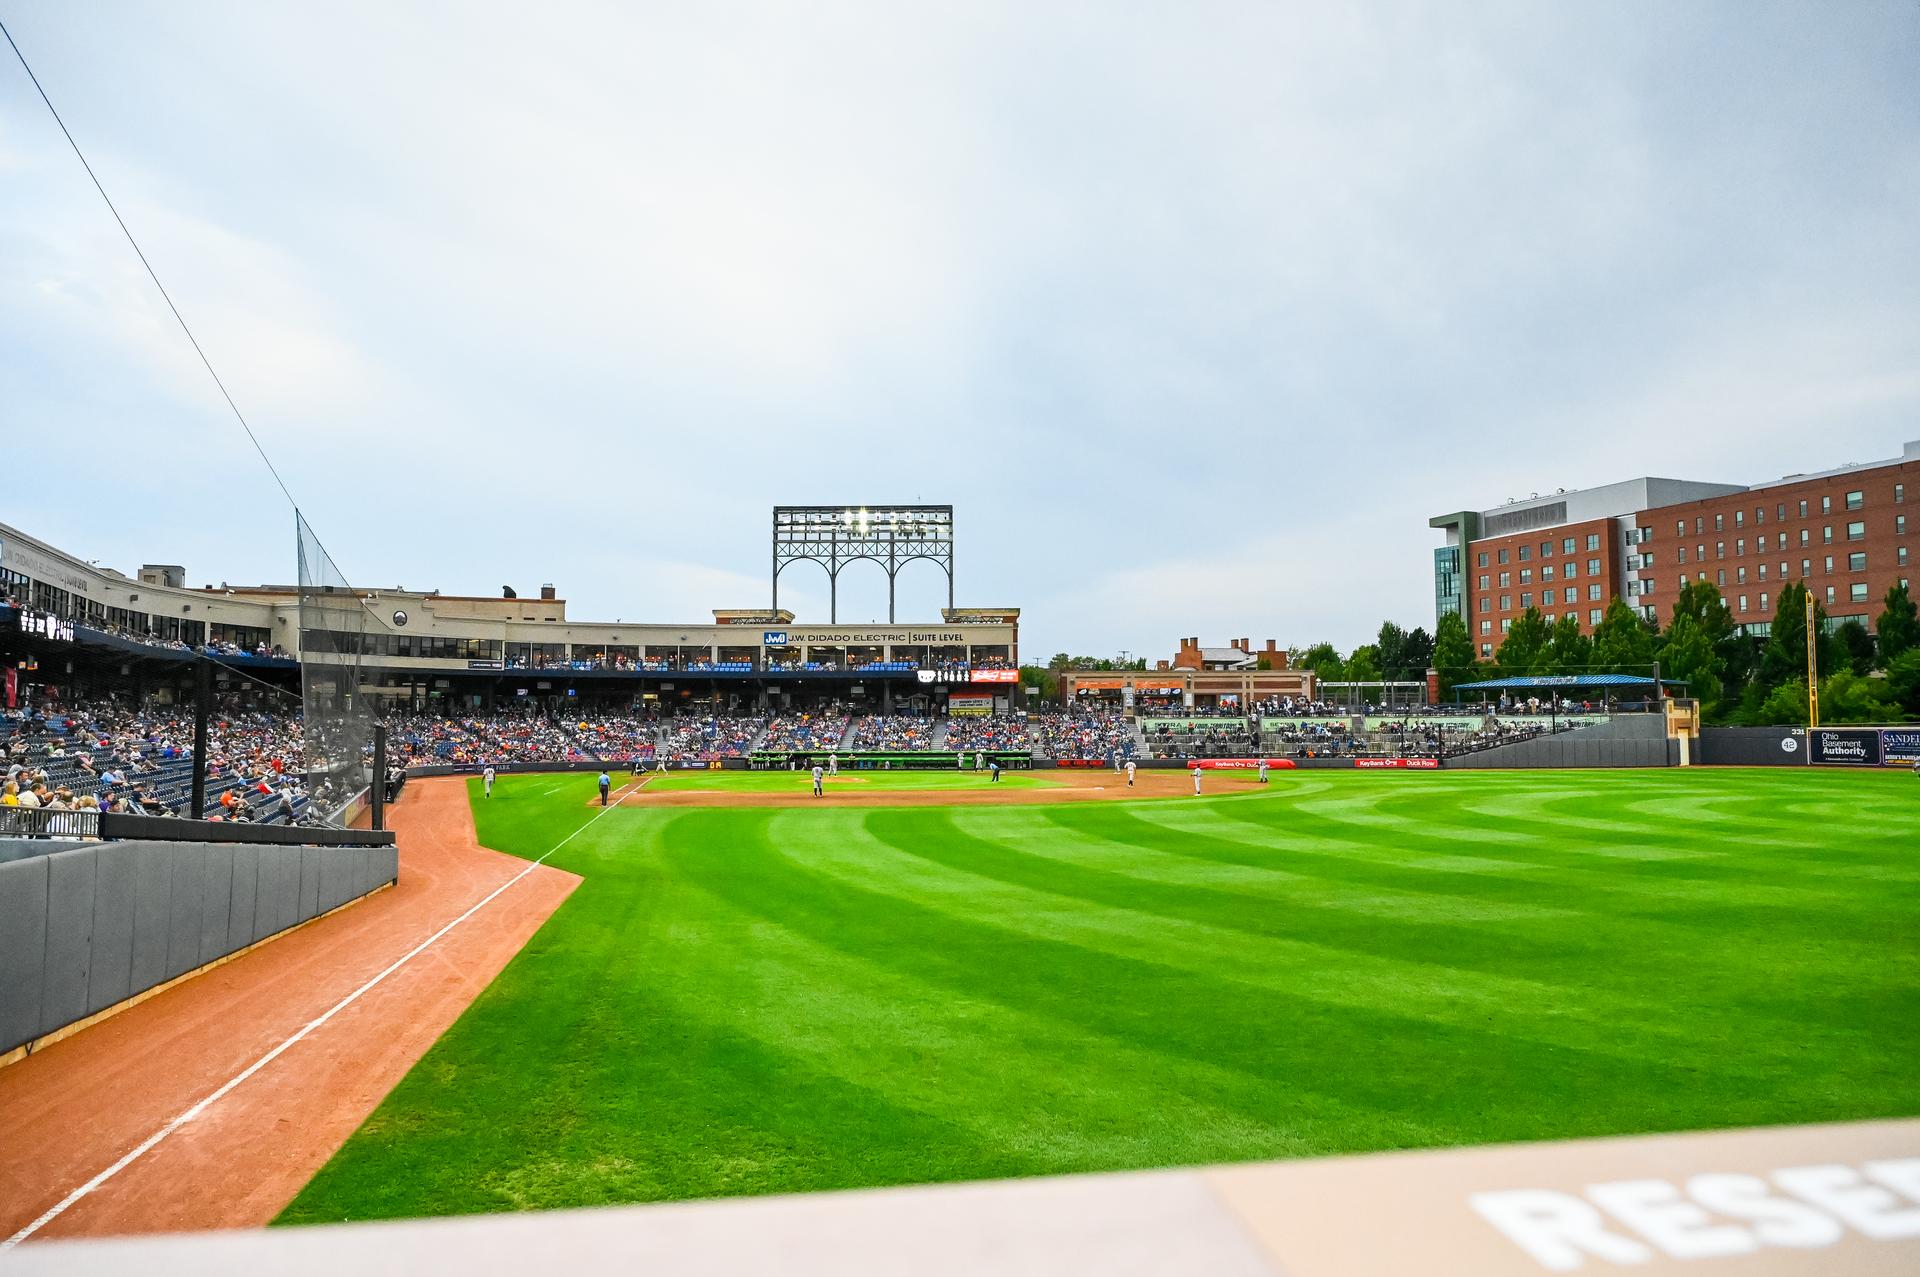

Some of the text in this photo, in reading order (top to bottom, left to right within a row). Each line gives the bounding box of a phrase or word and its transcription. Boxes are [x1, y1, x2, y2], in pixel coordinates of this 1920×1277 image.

[807, 634, 851, 642] DIDADO
[853, 634, 906, 642] ELECTRIC
[912, 633, 937, 642] SUITE
[939, 633, 964, 642] LEVEL
[1821, 732, 1839, 740] Ohio
[1783, 741, 1795, 749] 42
[1822, 739, 1862, 748] Basement
[1822, 747, 1866, 757] Authority
